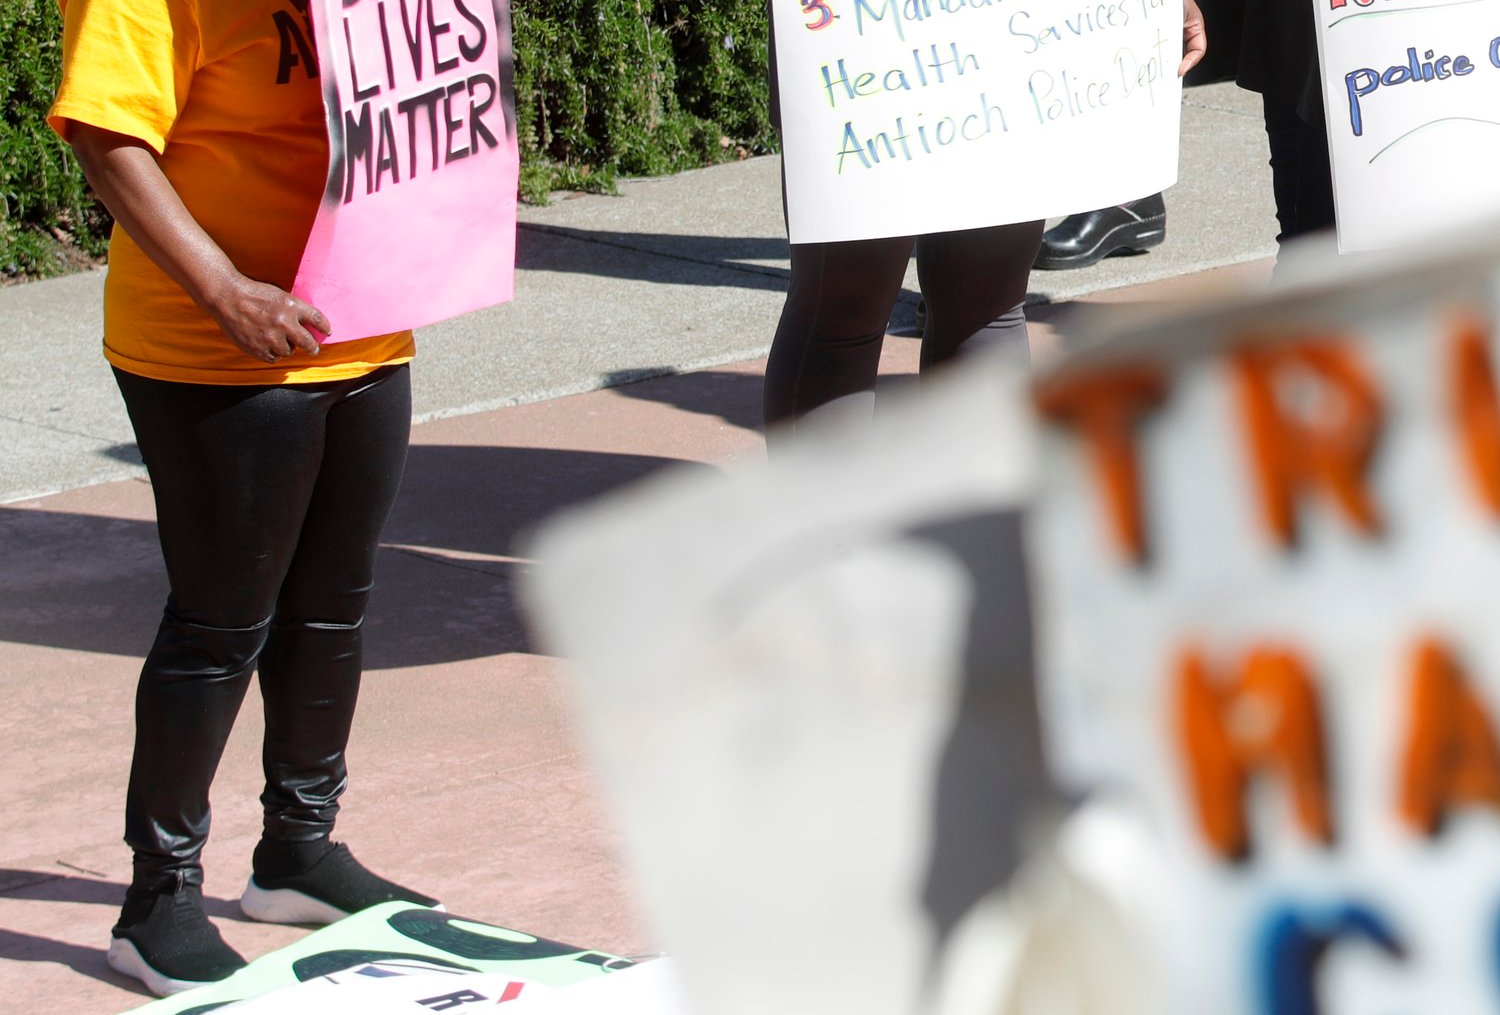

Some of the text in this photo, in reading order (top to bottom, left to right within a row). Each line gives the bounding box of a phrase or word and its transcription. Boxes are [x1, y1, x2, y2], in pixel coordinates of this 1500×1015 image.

[820, 41, 981, 108] Health
[836, 91, 1009, 174] Antioch
[1027, 68, 1111, 126] Police
[1344, 46, 1475, 137] police
[342, 73, 500, 205] MATTER
